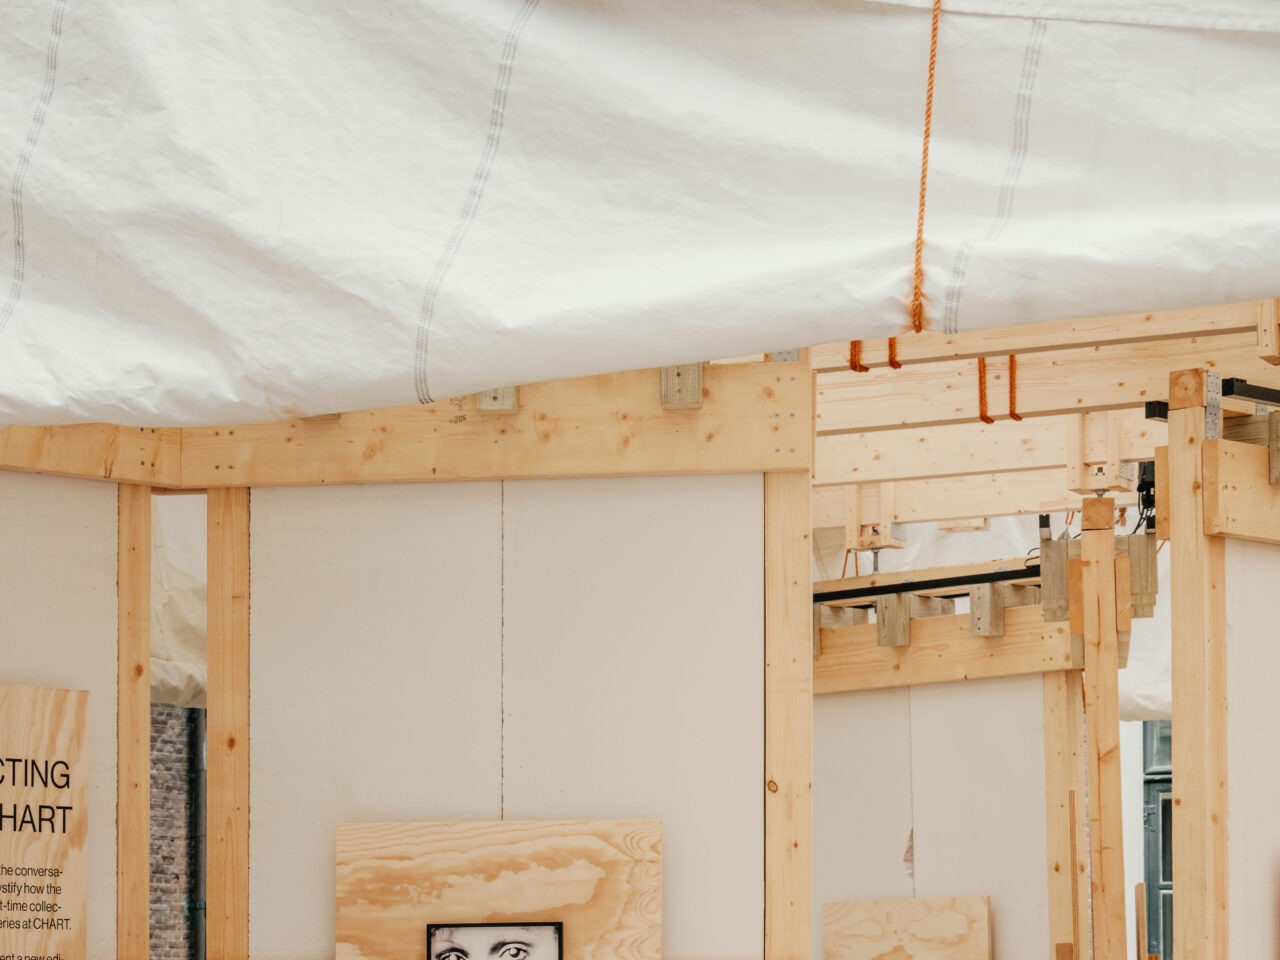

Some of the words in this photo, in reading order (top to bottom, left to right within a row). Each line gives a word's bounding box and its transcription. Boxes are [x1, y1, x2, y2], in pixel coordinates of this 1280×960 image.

[14, 865, 62, 876] conversa-
[23, 880, 44, 893] how
[46, 881, 61, 894] the
[22, 915, 30, 928] at
[32, 916, 70, 929] CHART.
